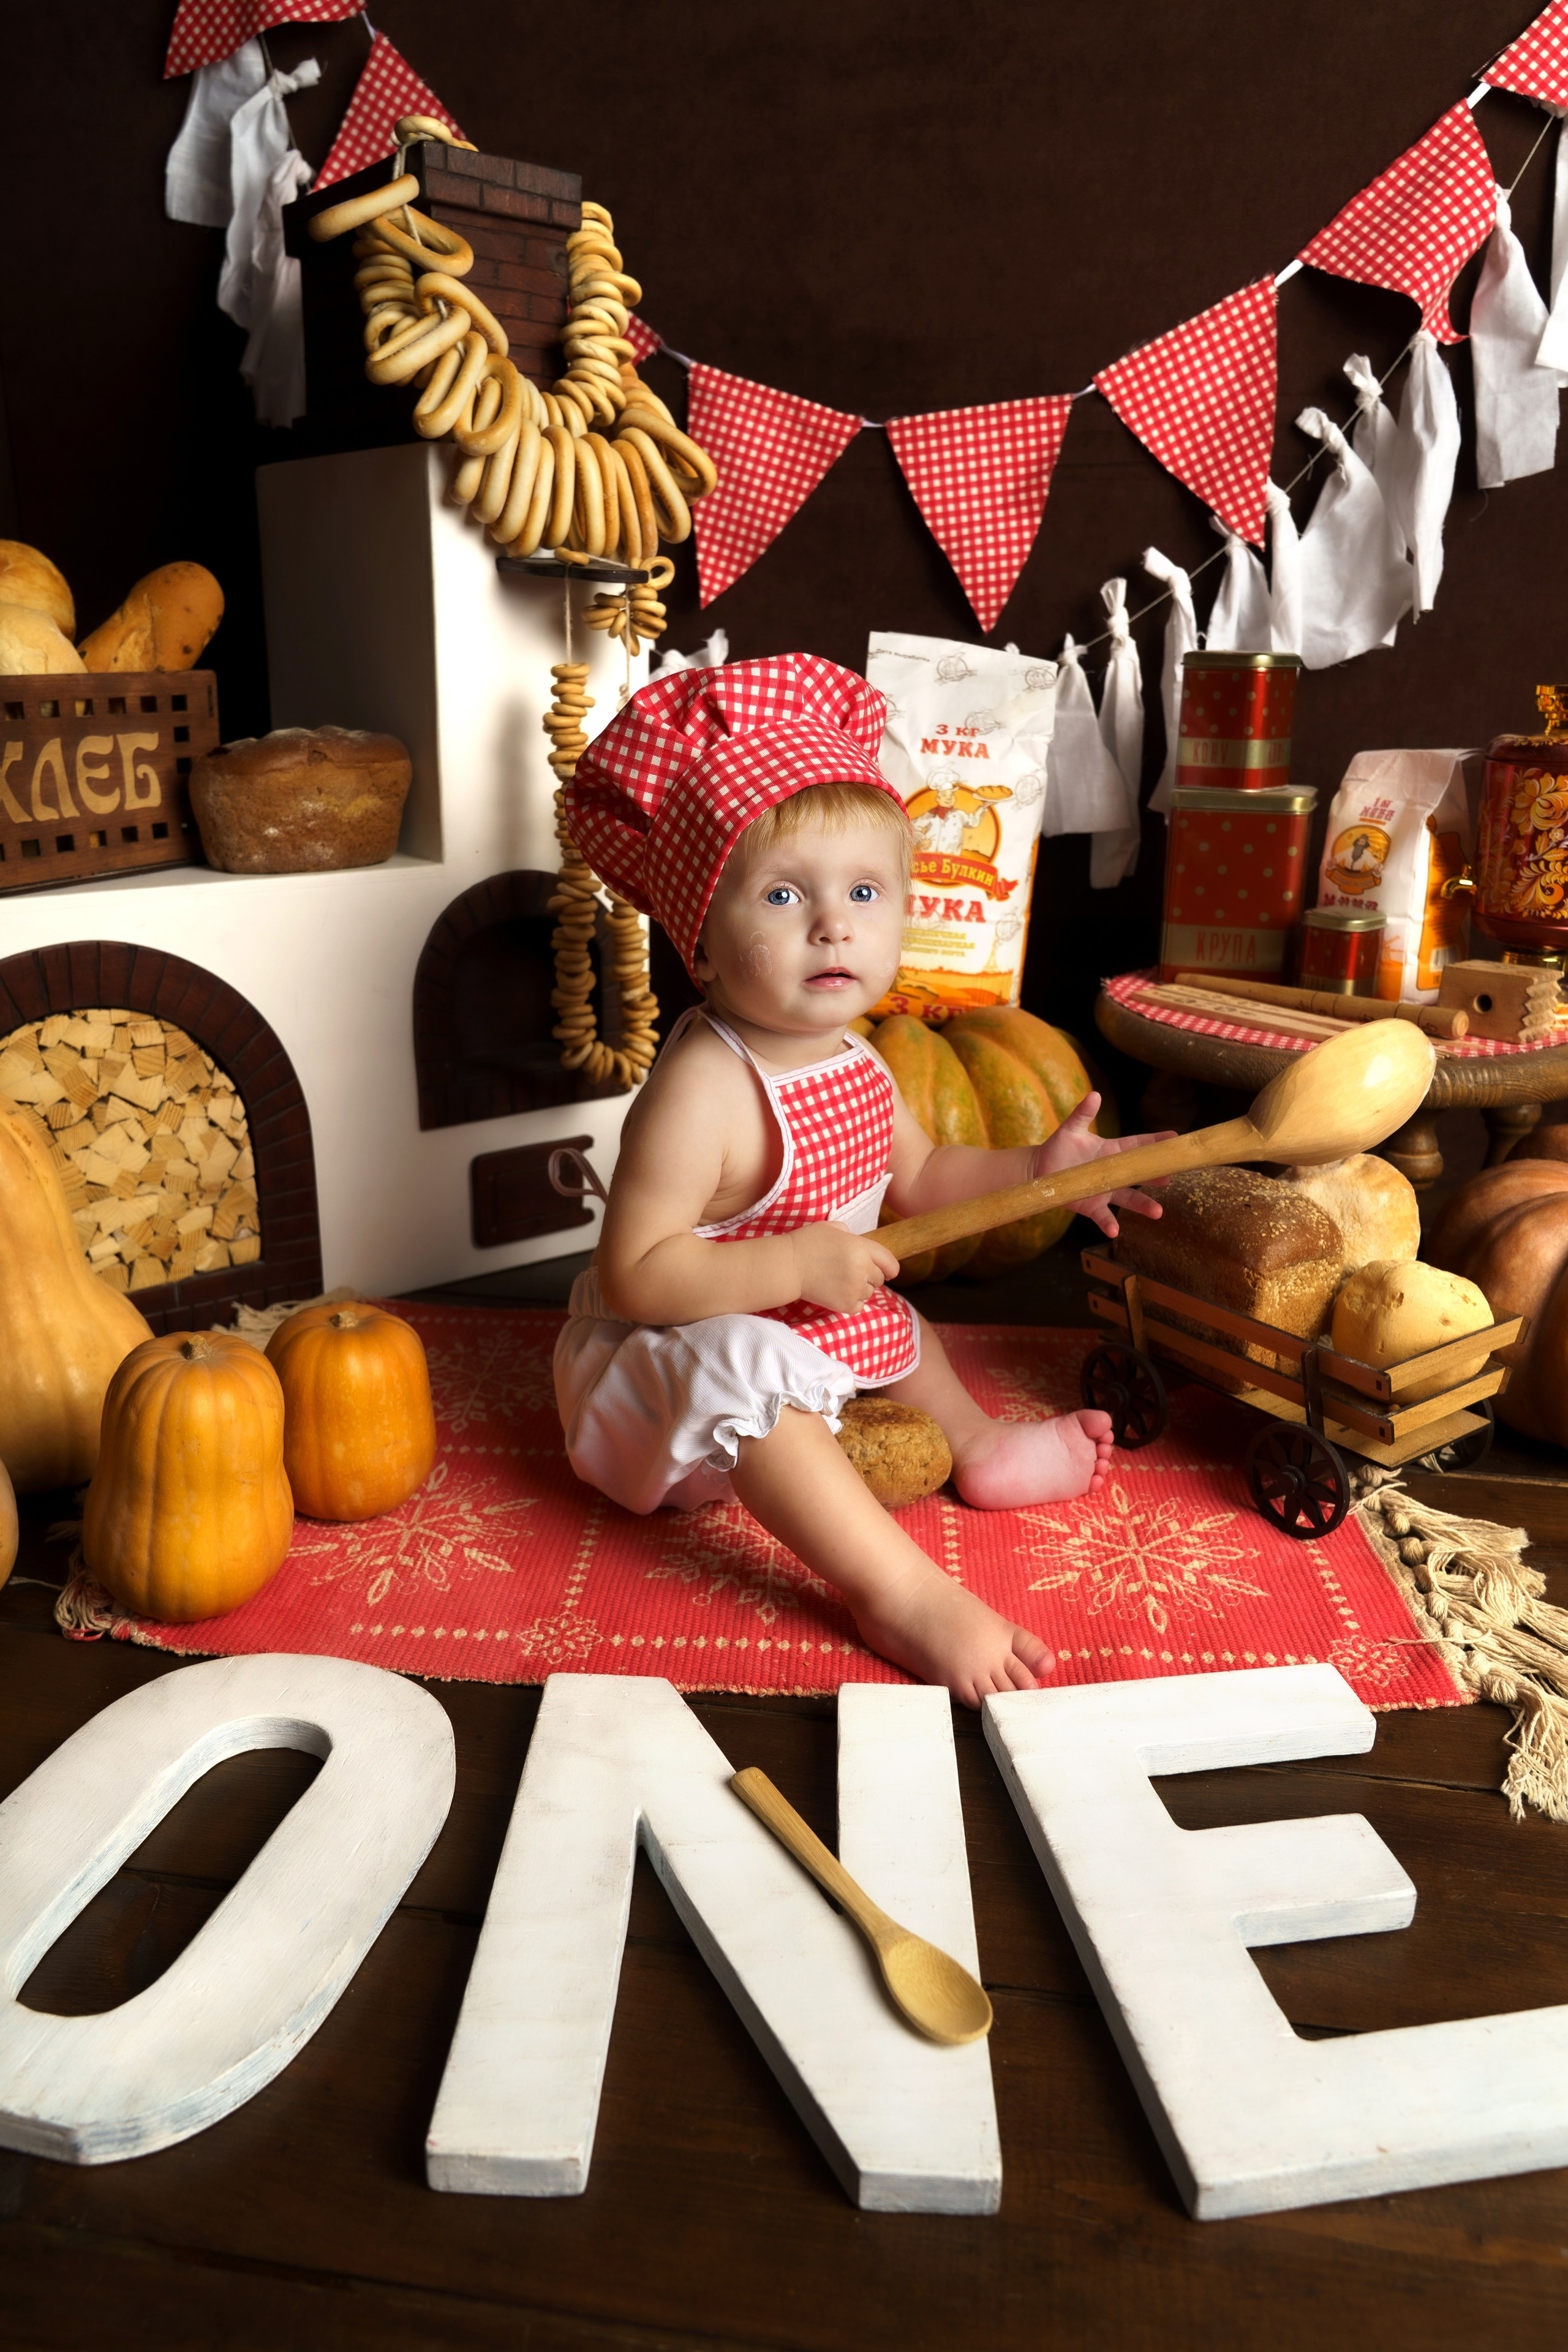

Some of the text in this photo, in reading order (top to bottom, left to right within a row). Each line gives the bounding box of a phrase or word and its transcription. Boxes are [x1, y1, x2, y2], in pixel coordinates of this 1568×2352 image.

[935, 724, 949, 735] 3
[920, 738, 990, 759] МУКА
[910, 859, 995, 887] сье Булкин
[1196, 932, 1256, 964] КРУПА
[889, 997, 909, 1016] 3
[0, 1653, 1568, 2221] ONE
